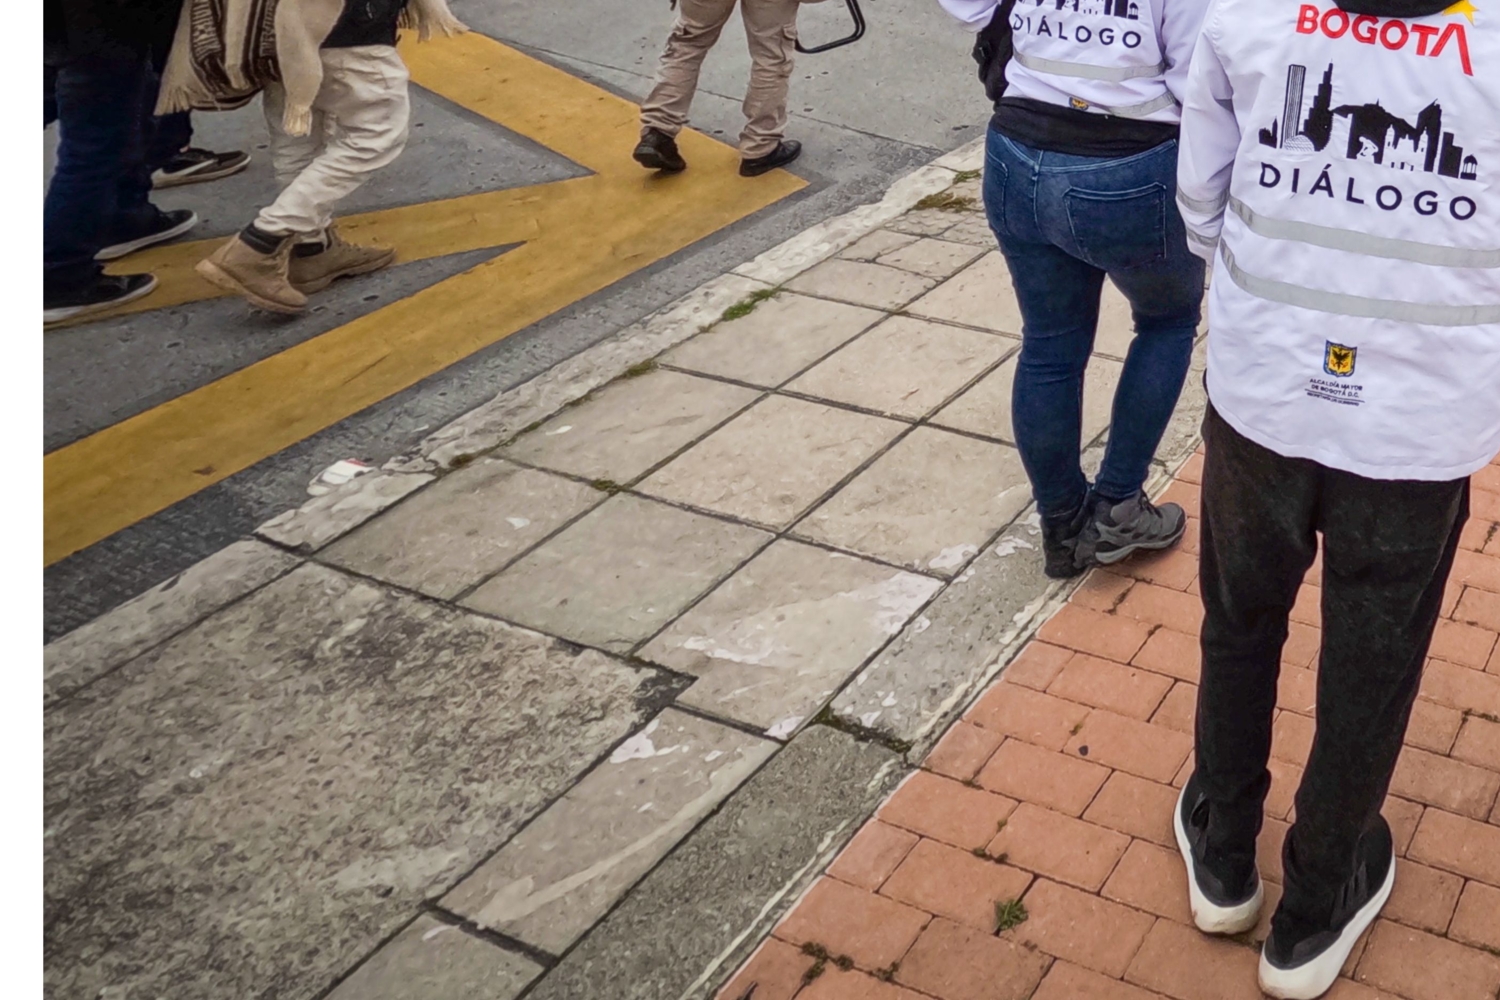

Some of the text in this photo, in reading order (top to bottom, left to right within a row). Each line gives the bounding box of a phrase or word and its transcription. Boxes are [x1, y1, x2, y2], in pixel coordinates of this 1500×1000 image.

[1011, 13, 1142, 49] DIÁLOGO
[1258, 162, 1477, 221] DIÁLOGO
[1309, 378, 1340, 389] ALCALDÍA
[1320, 386, 1346, 396] BOGOTÁ
